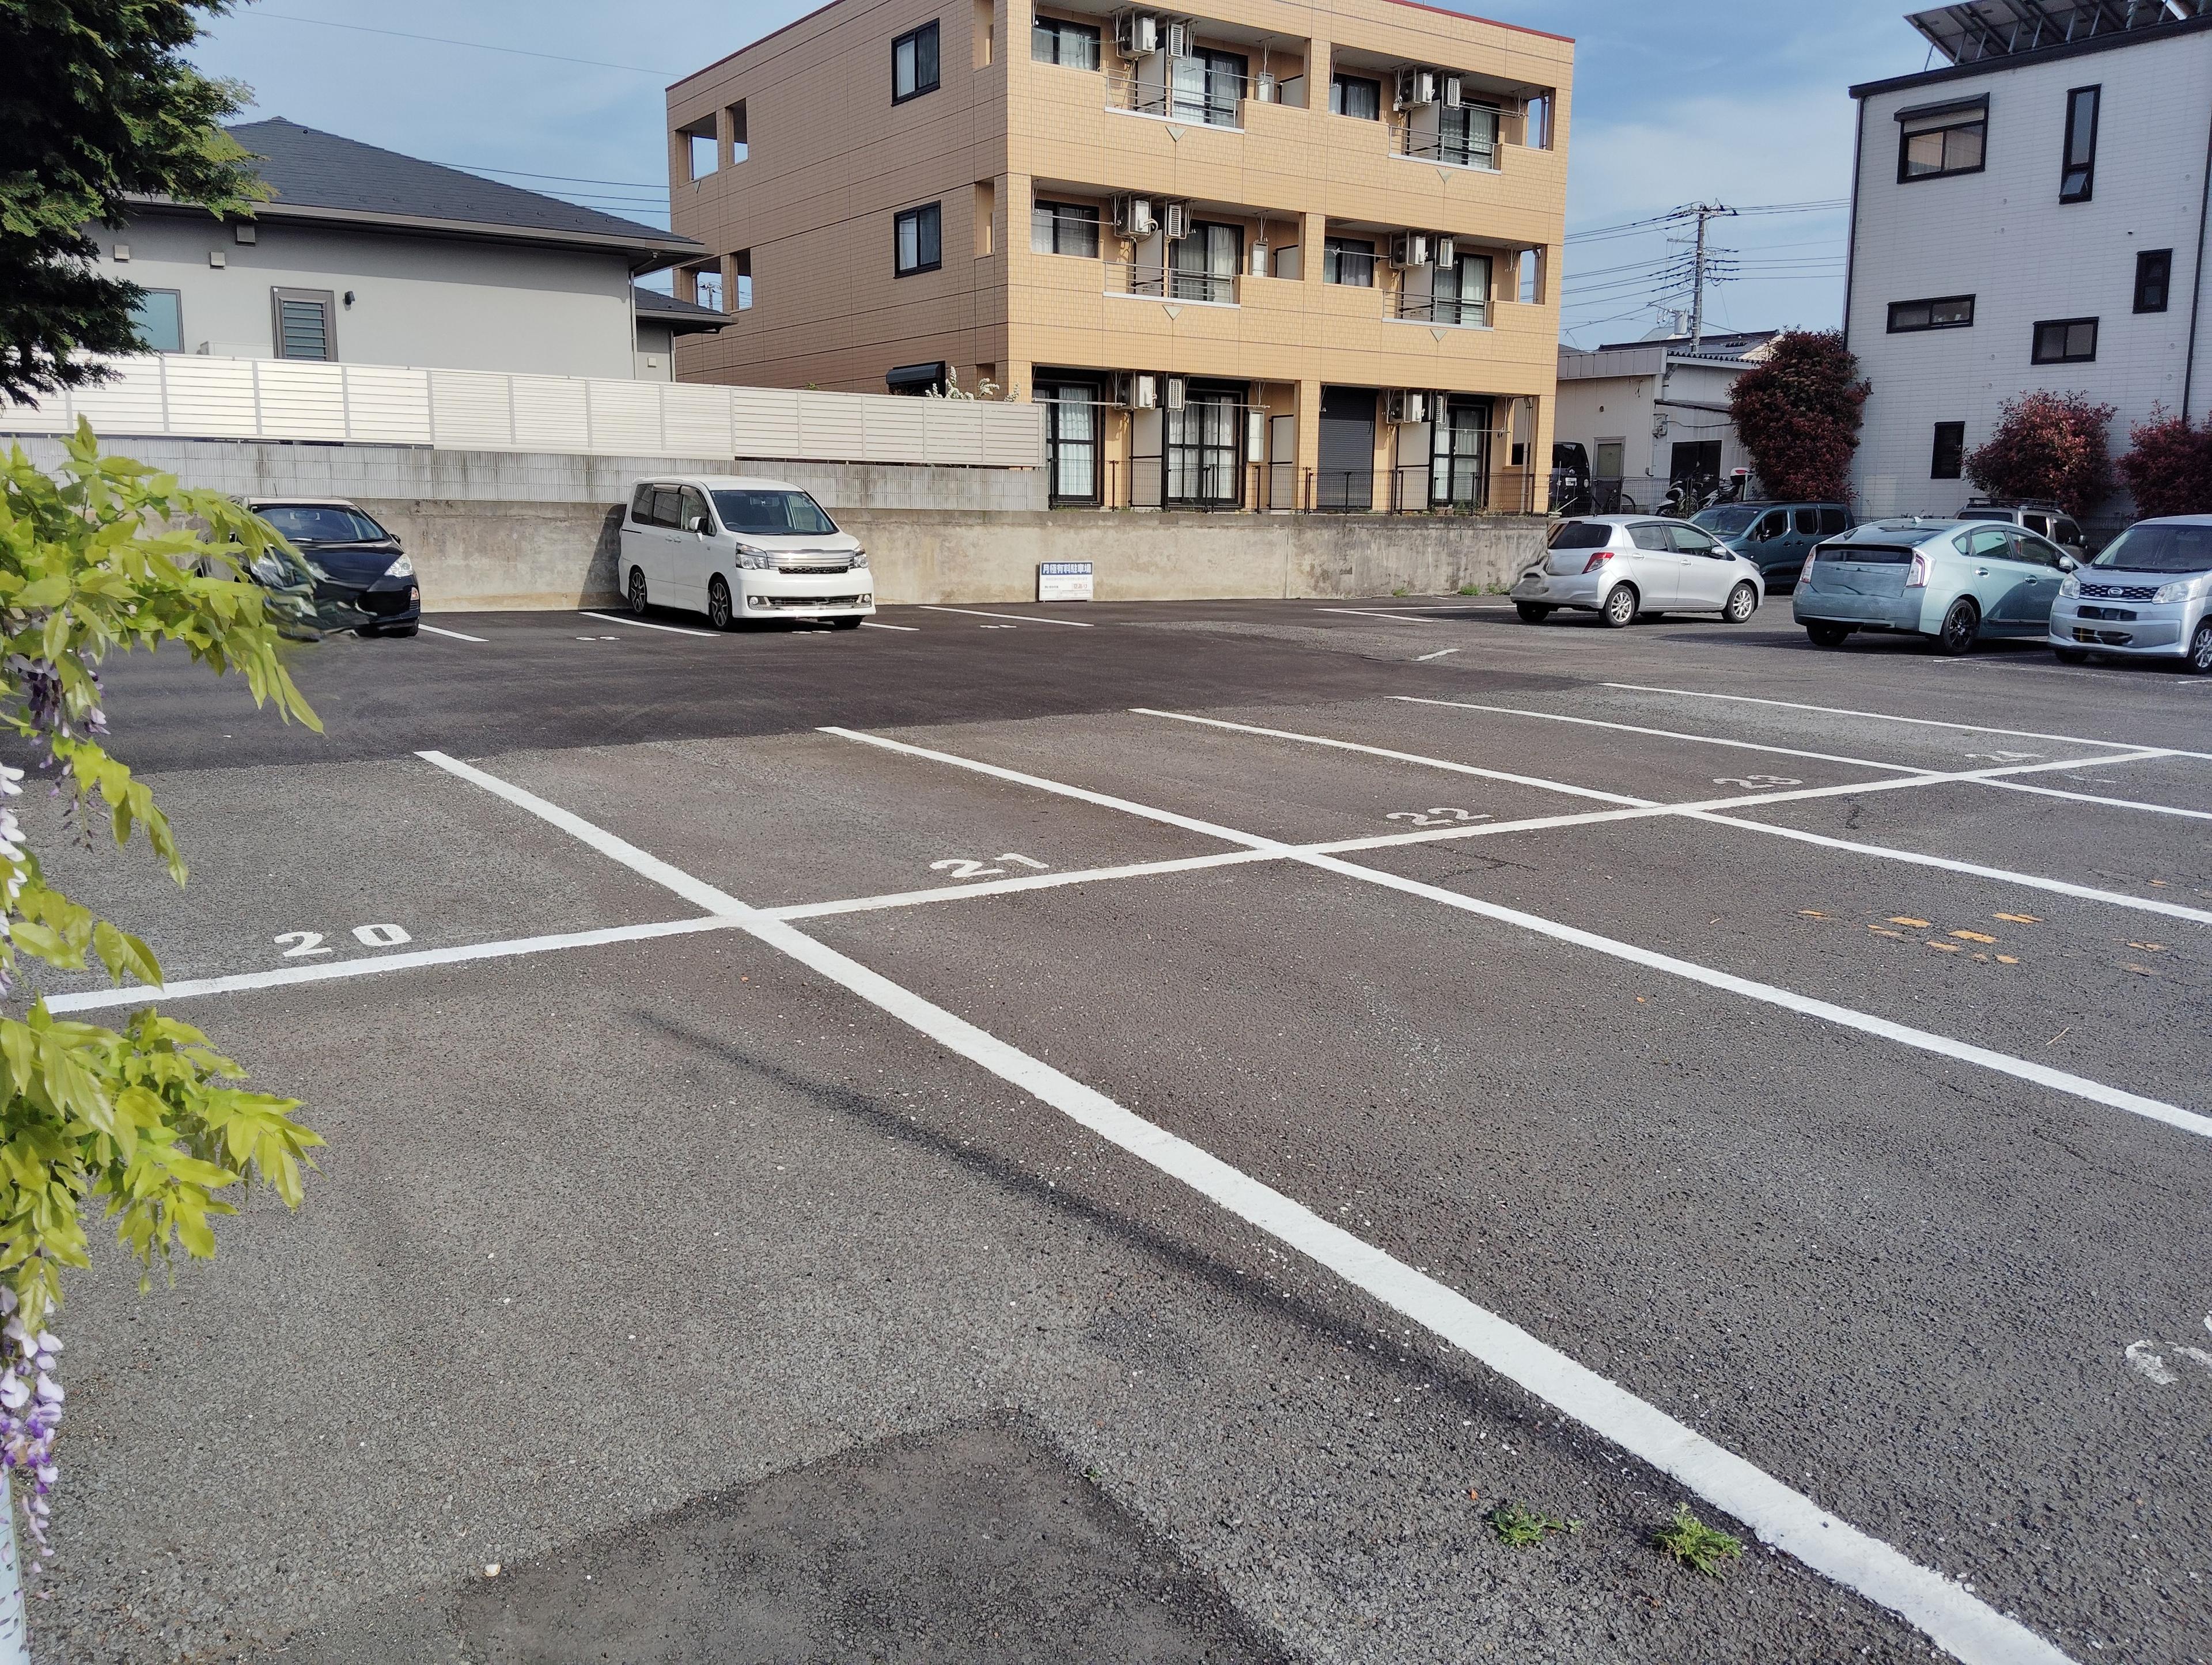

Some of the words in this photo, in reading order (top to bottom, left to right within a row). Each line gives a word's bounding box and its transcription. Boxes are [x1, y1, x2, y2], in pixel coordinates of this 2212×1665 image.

[1043, 563, 1092, 574] 月極有料駐車場
[1964, 750, 2044, 762] 24
[1713, 775, 1803, 789] 23
[1386, 807, 1494, 825] 22
[929, 853, 1050, 878] 21
[273, 923, 412, 957] 20
